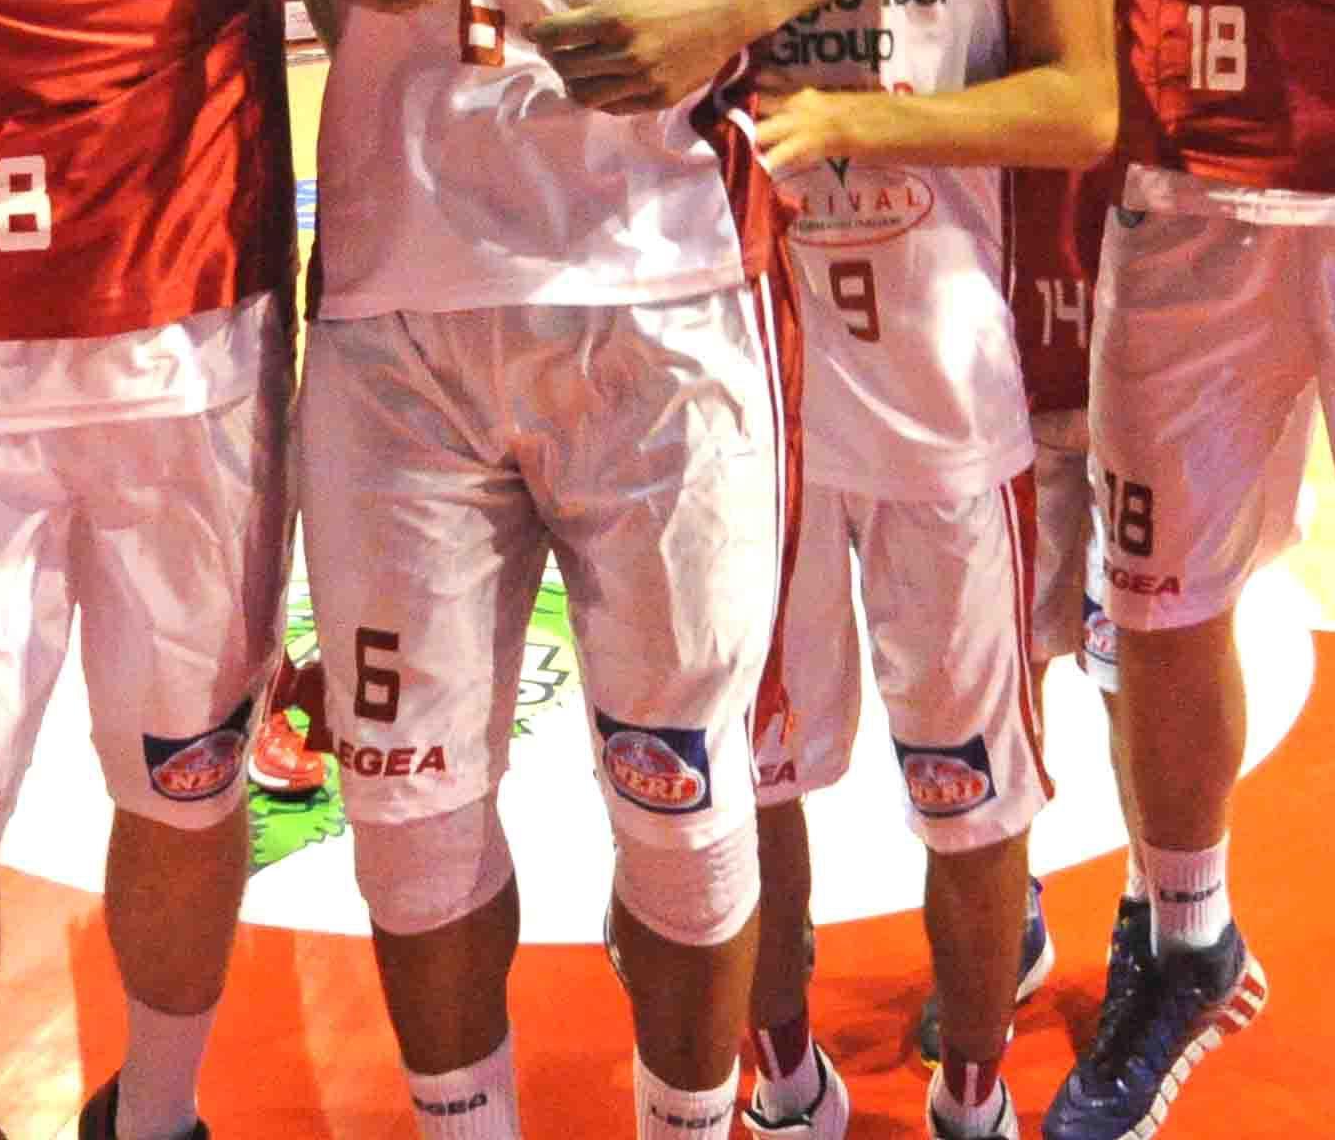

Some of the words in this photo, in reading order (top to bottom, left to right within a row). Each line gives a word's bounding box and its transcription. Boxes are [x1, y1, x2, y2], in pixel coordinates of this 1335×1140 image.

[1187, 4, 1247, 92] 18
[828, 260, 880, 343] 9
[1036, 278, 1088, 349] 14
[352, 626, 400, 724] 6
